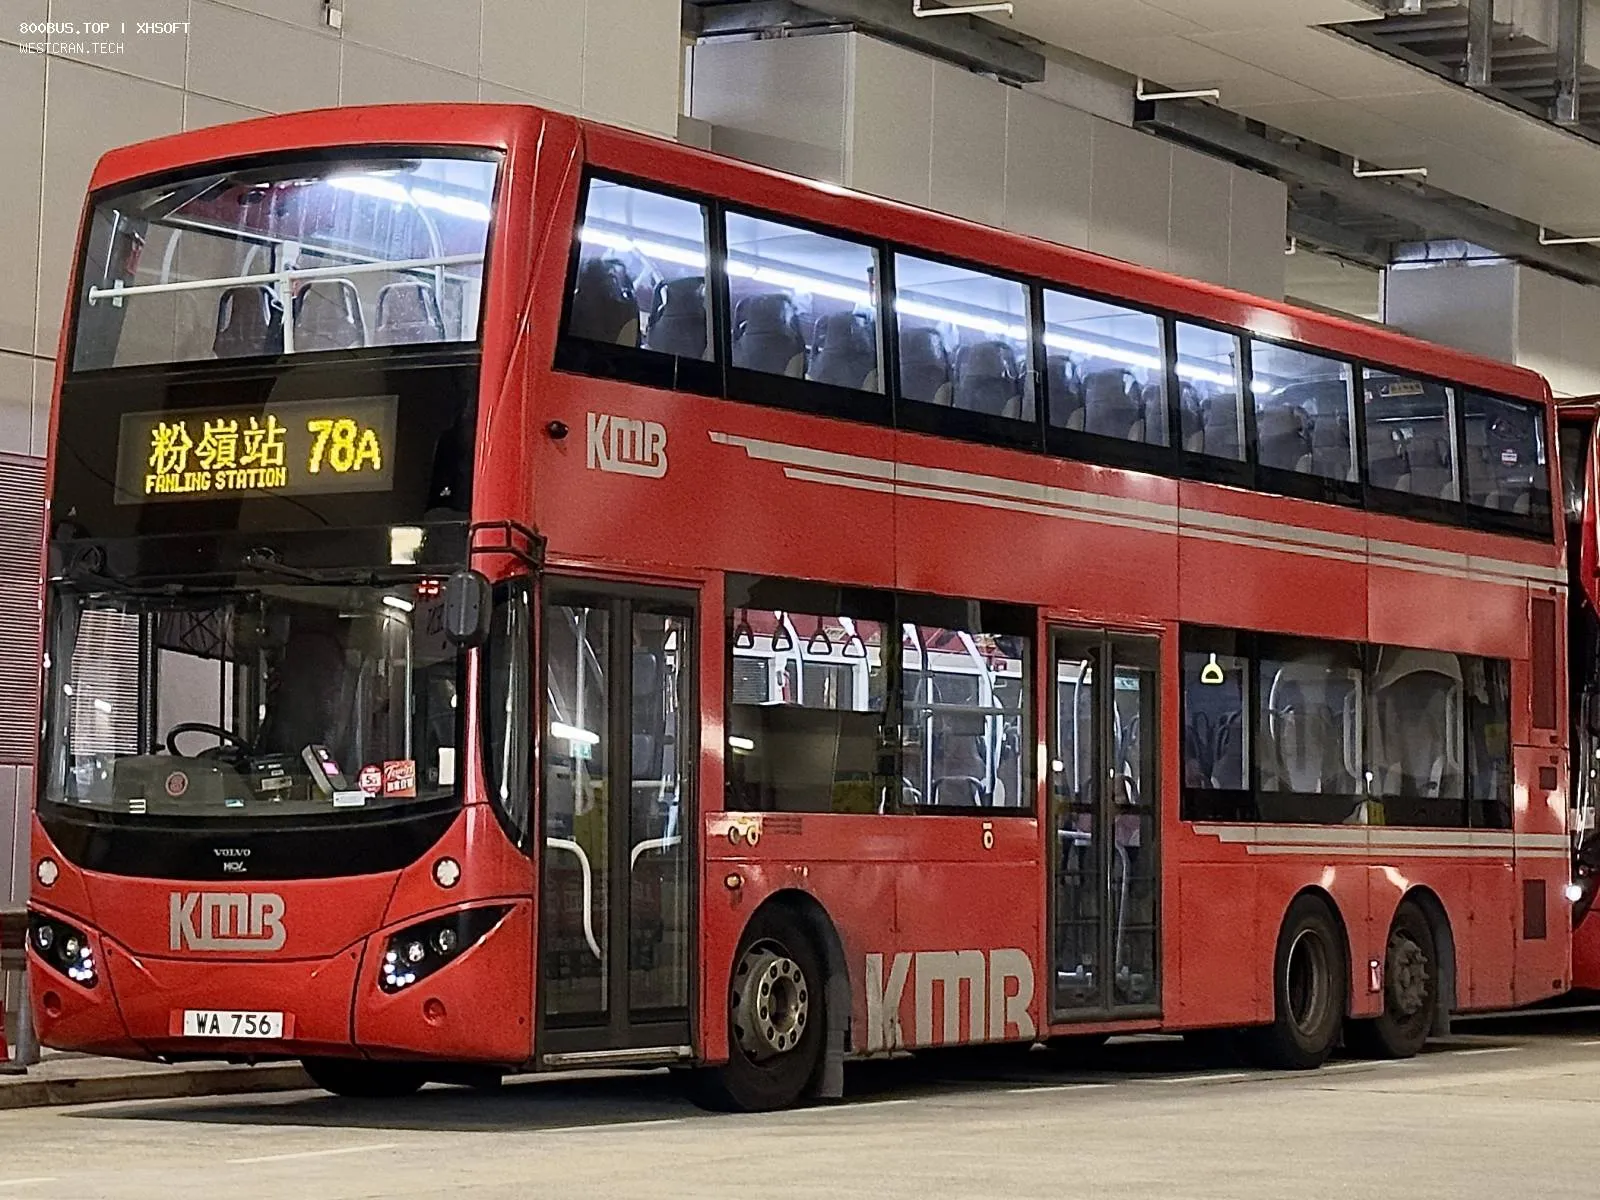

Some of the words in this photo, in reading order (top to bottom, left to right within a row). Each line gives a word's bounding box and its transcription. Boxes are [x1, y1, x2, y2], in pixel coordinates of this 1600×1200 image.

[150, 415, 287, 474] 粉嶺站
[307, 418, 382, 473] 78A
[586, 411, 669, 479] KMB
[145, 473, 211, 494] FANLING
[214, 467, 287, 490] STATION
[213, 848, 251, 857] VOLVO
[169, 892, 287, 951] KMB
[196, 1012, 221, 1034] WA
[231, 1014, 272, 1036] 756
[865, 948, 1036, 1052] KMB
